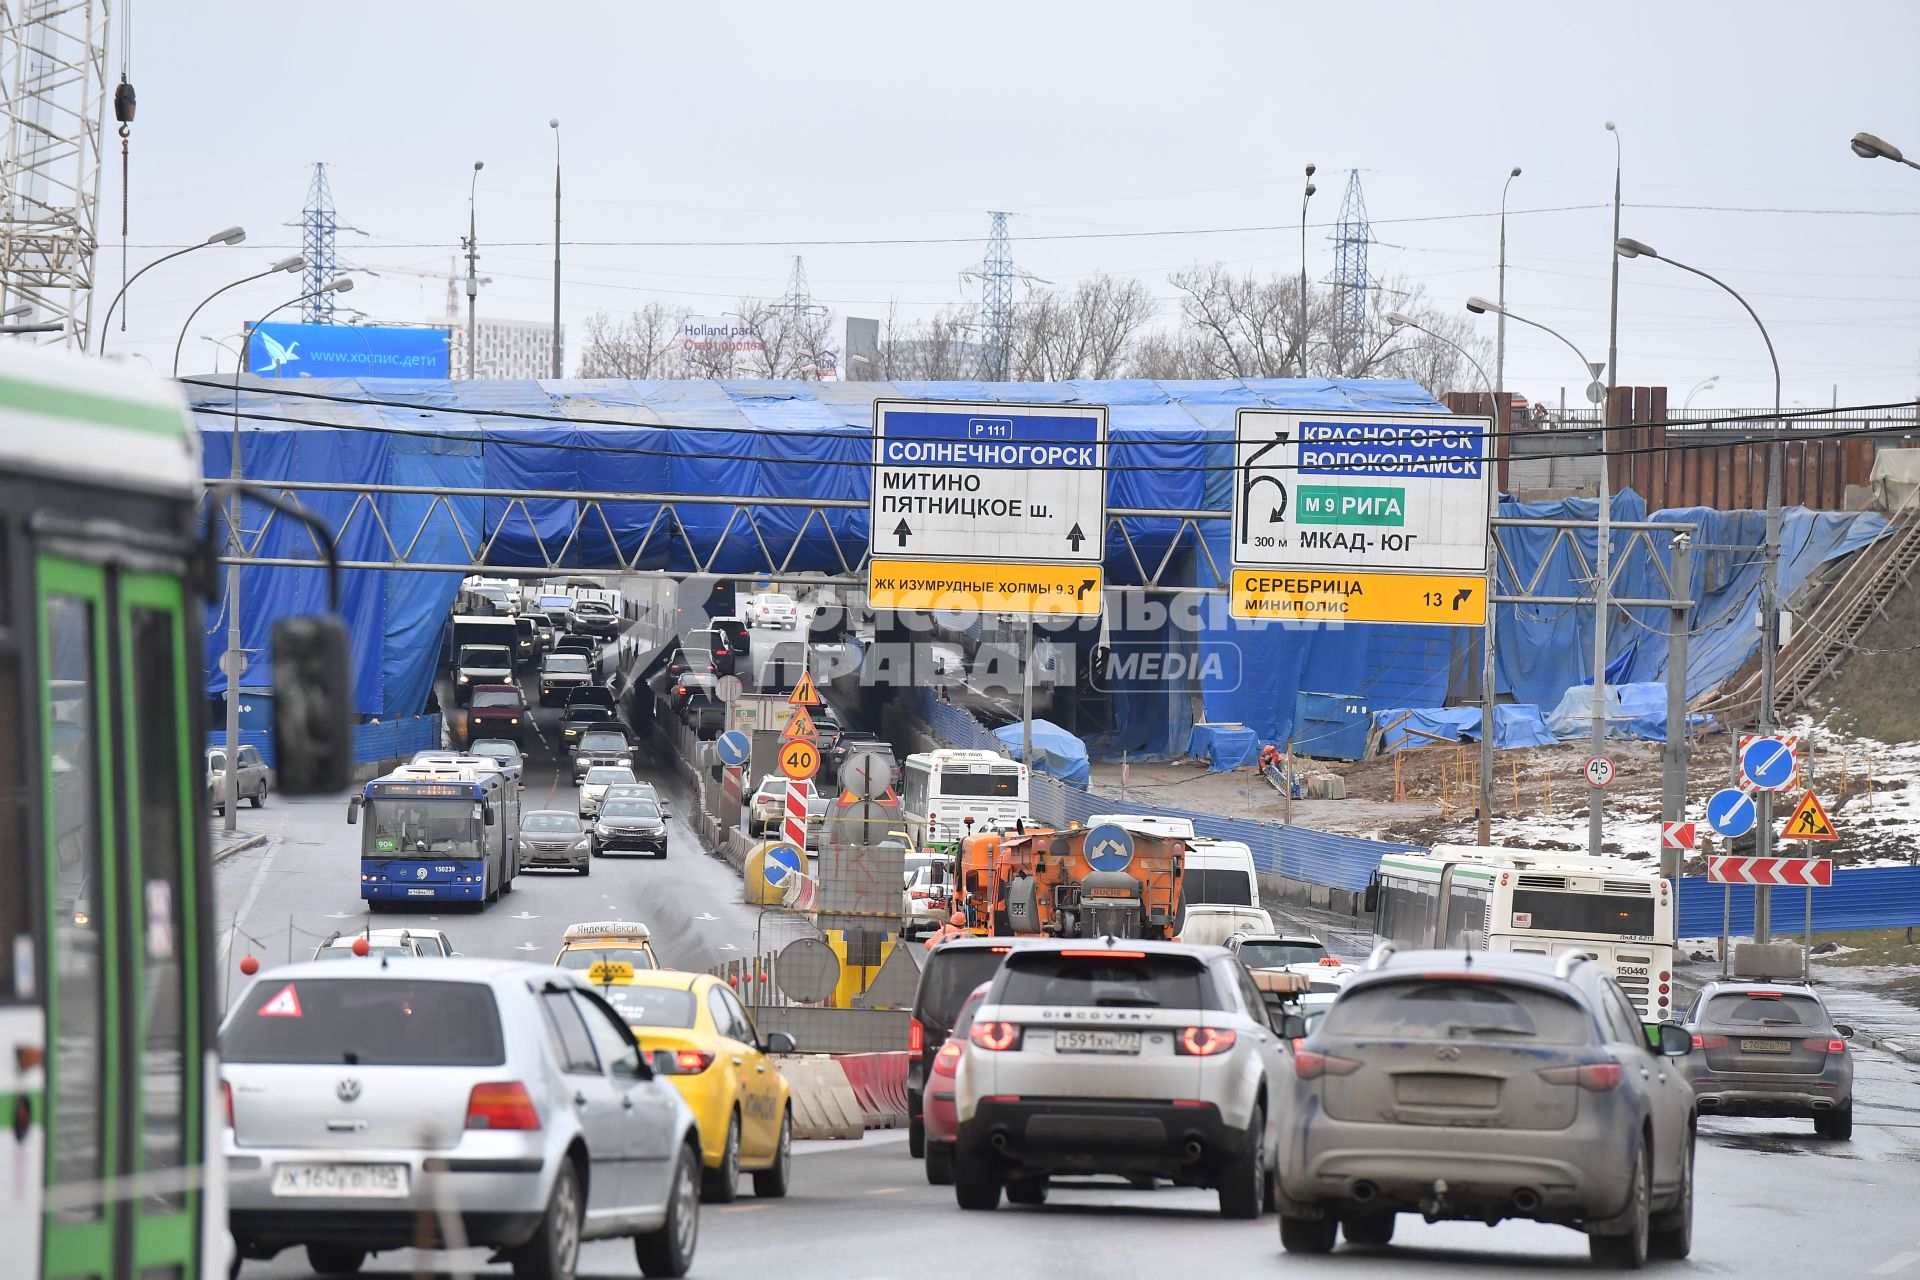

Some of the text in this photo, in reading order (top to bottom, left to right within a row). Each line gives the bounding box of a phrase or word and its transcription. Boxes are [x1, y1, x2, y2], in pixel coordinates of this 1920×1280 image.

[684, 324, 757, 339] Holland park
[310, 351, 436, 367] www.хоспис.дети
[987, 425, 1006, 436] 111
[1304, 426, 1474, 449] КРАСНОГОРСК
[888, 442, 1093, 465] СОЛНЕЧНОГОРСК
[1303, 452, 1478, 475] ВОЛОКОЛАМСК
[883, 472, 981, 492] МИТИНО
[882, 496, 1053, 519] ПЯТНИЦКОЕ ш.
[1325, 498, 1335, 512] 9
[1342, 497, 1402, 516] РИГА
[1254, 537, 1274, 547] 300
[1300, 531, 1418, 553] МКАД- ЮГ
[874, 579, 1074, 595] ЖК ИЗУМРУДНЫЕ ХОЛМЫ 9.3
[1245, 578, 1363, 597] СЕРЕБРИЦА
[1423, 592, 1443, 607] 13
[787, 752, 811, 768] 40
[577, 923, 638, 934] Яндекс Такси
[1616, 966, 1648, 976] 150440
[1042, 1012, 1153, 1020] DISCOVERY
